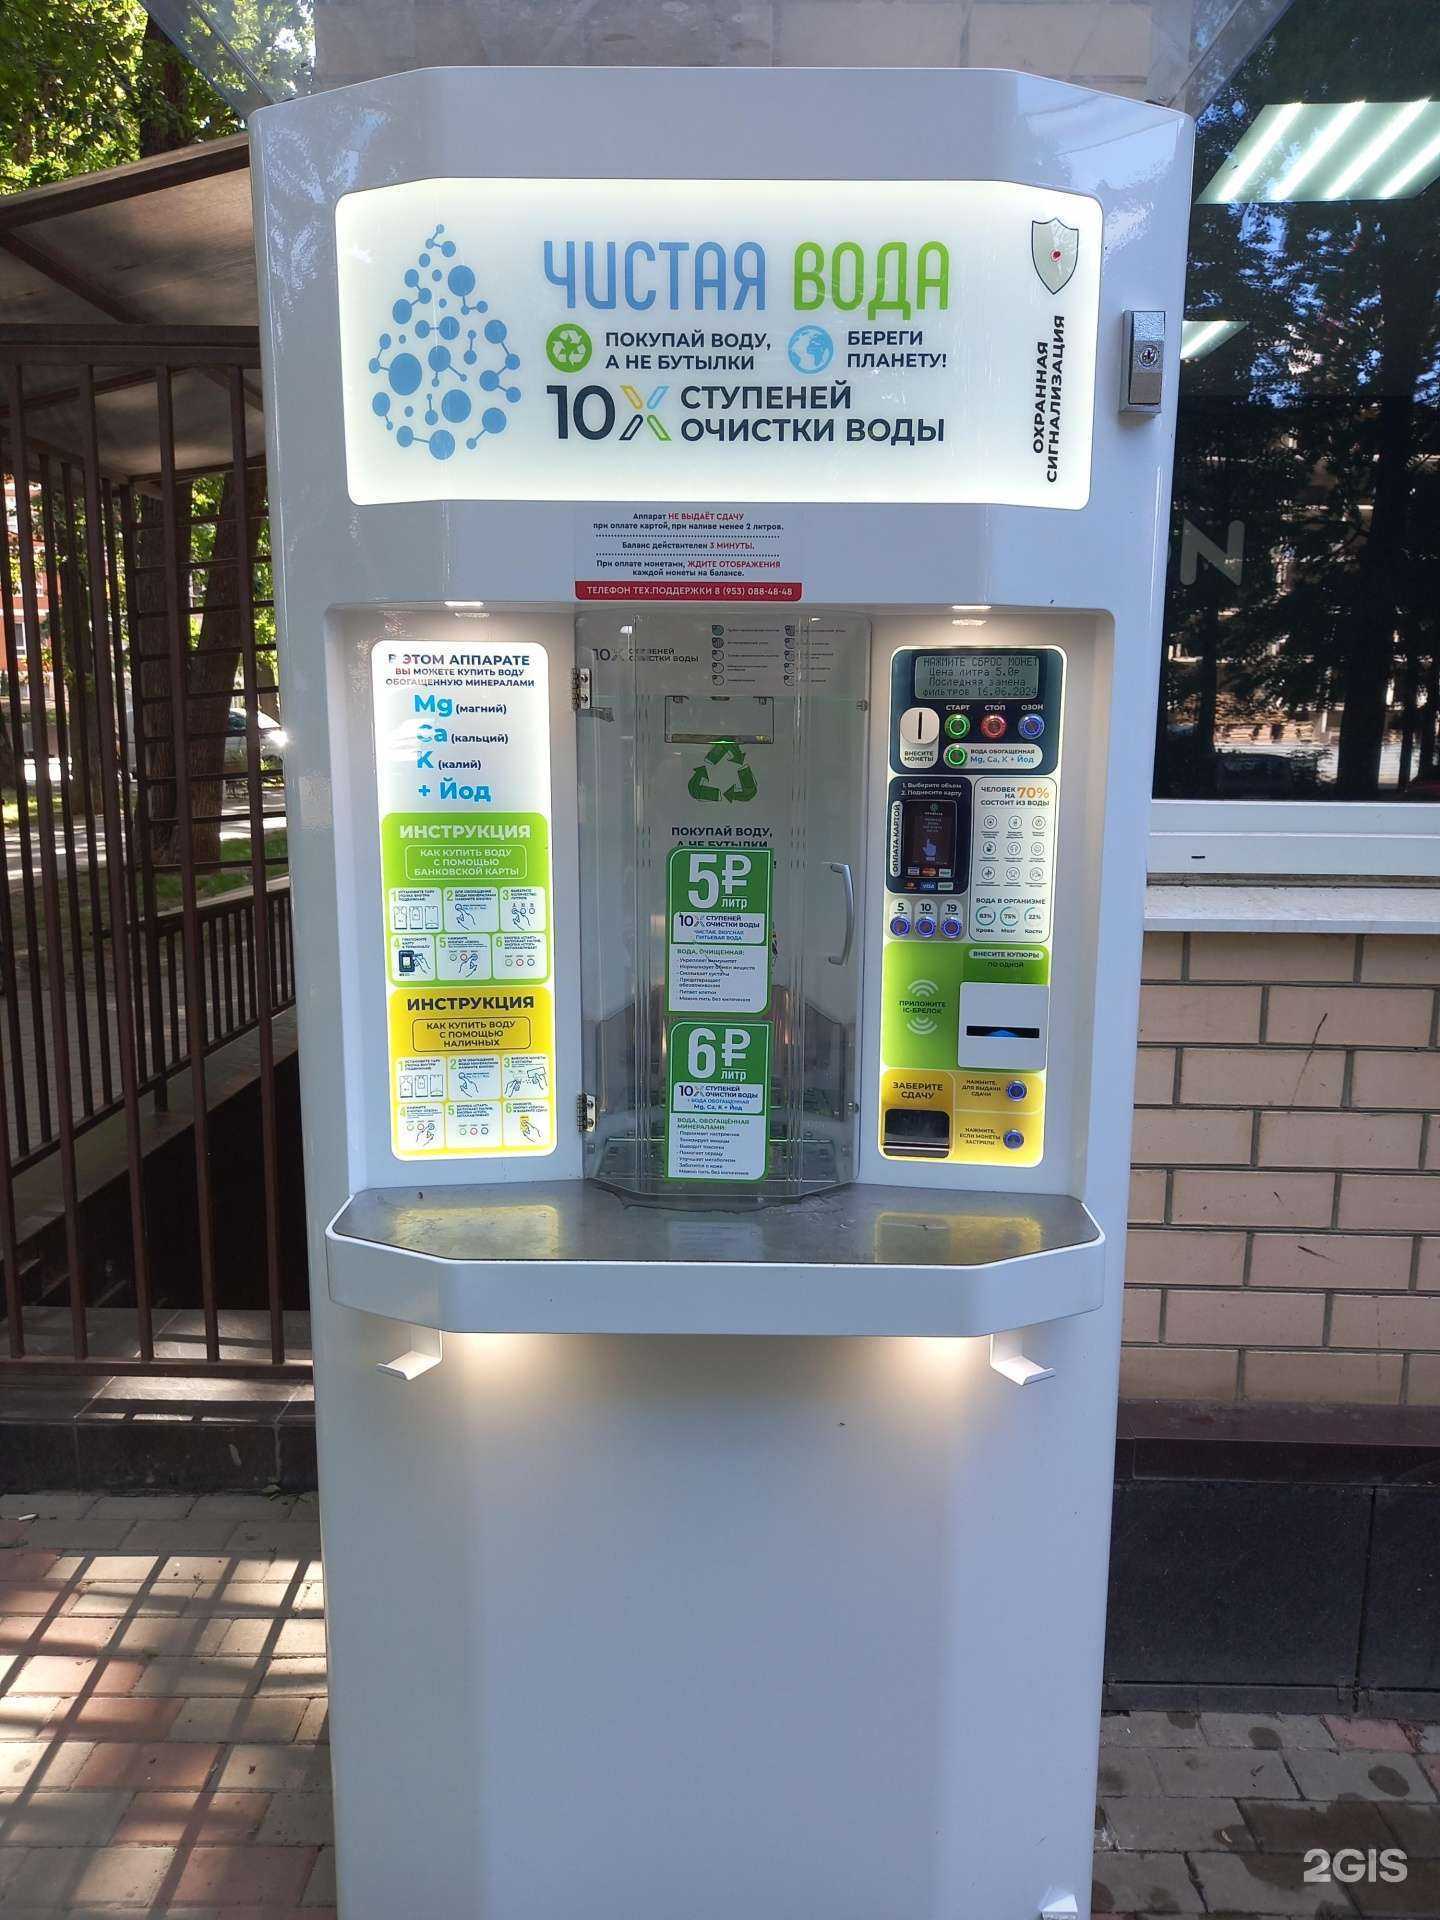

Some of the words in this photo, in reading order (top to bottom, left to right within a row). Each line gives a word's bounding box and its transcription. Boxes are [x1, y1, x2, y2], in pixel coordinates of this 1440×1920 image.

[543, 240, 766, 311] ЧИСТАЯ
[793, 241, 949, 321] ВОДА
[605, 327, 706, 348] ПОКУПАЙ
[711, 332, 771, 352] ВОДУ,
[847, 331, 924, 347] БЕРЕГИ
[605, 356, 619, 370] А
[625, 355, 650, 370] НЕ
[657, 355, 754, 370] БУТЫЛКИ
[846, 352, 947, 370] ПЛАНЕТУ!
[681, 380, 852, 410] СТУПЕНЕЙ
[1033, 342, 1048, 453] ОХРАННАЯ
[1047, 315, 1065, 483] СИГНАЛИЗАЦИЯ
[681, 418, 837, 443] ОЧИСТКИ
[846, 419, 945, 446] ВОДЫ
[633, 513, 666, 521] Аппарат
[716, 513, 744, 521] СДАЧУ
[593, 523, 608, 531] при
[610, 523, 638, 531] оплате
[671, 523, 687, 531] при
[753, 523, 784, 531] литров.
[622, 542, 650, 550] Баланс
[652, 542, 708, 550] действителен
[596, 560, 613, 568] При
[615, 561, 642, 569] оплате
[719, 561, 781, 569] ОТОБРАЖЕНИЯ
[633, 569, 664, 578] каждой
[666, 569, 695, 577] монеты
[710, 569, 744, 577] балансе.
[587, 587, 631, 595] ТЕЛЕФОН
[723, 588, 745, 596] (953)
[747, 588, 793, 596] 088-48-48
[402, 654, 445, 665] ЭТОМ
[449, 655, 530, 666] АППАРАТЕ
[923, 657, 966, 667] НАЖМИТЕ
[972, 657, 1002, 667] СБРОС
[1007, 657, 1038, 667] МОНЕТ
[413, 668, 455, 676] МОЖЕТЕ
[498, 669, 524, 677] ВОДУ
[929, 668, 953, 677] Цена
[959, 669, 990, 677] литра
[465, 679, 535, 687] МИНЕРАЛАМИ
[929, 678, 984, 687] Последняя
[990, 679, 1026, 687] замена
[414, 694, 453, 717] Mg
[455, 704, 507, 715] (магний)
[451, 734, 509, 744] (кальций)
[438, 760, 482, 771] (калий)
[440, 777, 492, 802] Йод
[1017, 787, 1049, 799] 70%
[400, 825, 531, 840] ИНСТРУКЦИЯ
[672, 826, 732, 836] ПОКУПАЙ
[736, 827, 773, 838] ВОДУ,
[484, 849, 512, 858] ВОДУ
[443, 859, 500, 867] ПОМОЩЬЮ
[414, 866, 483, 876] БАНКОВСКОЙ
[485, 868, 519, 876] КАРТЫ
[897, 903, 904, 911] 5
[947, 904, 957, 912] 19
[407, 996, 534, 1011] ИНСТРУКЦИЯ
[444, 1039, 500, 1047] НАЛИЧНЫХ
[893, 1082, 943, 1091] ЗАБЕРИТЕ
[901, 1091, 934, 1099] СДАЧУ
